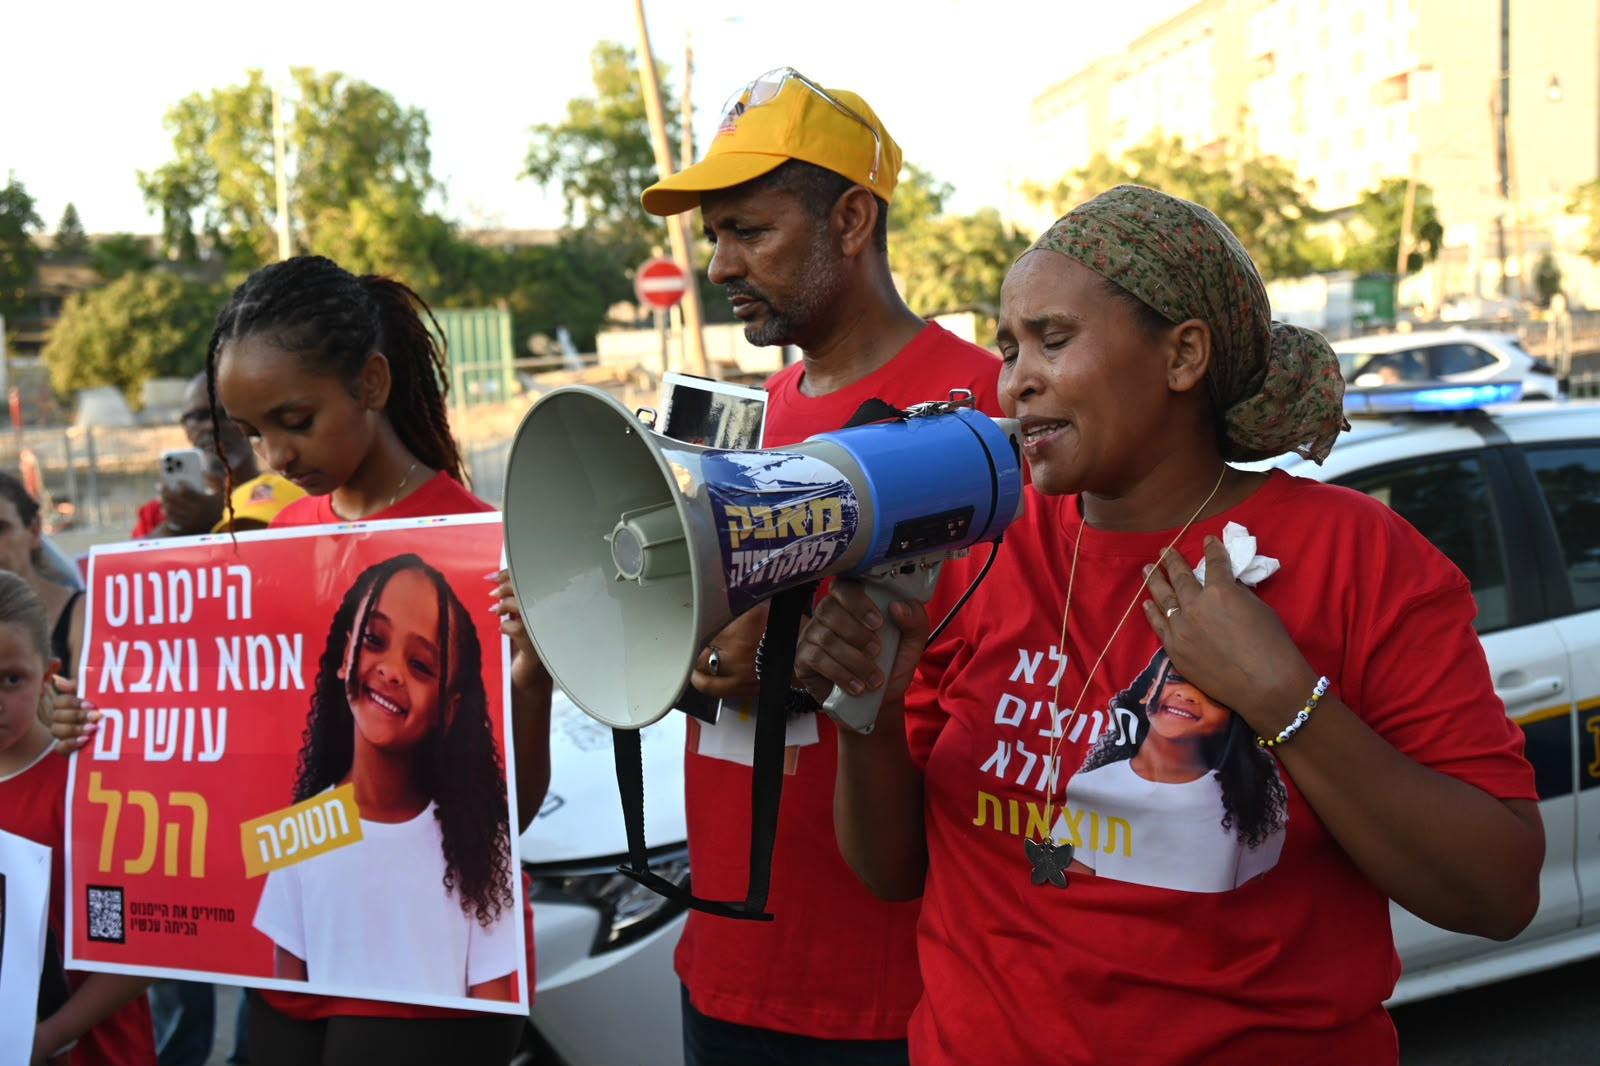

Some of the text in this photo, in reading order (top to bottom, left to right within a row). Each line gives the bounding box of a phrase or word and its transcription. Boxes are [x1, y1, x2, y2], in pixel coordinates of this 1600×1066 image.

[723, 496, 842, 549] מאבק
[105, 565, 252, 627] היימנוט
[98, 633, 305, 693] אמא ואבא
[1008, 645, 1068, 687] לא
[93, 707, 227, 762] עושים
[979, 739, 1061, 794] אלא
[88, 771, 209, 878] הכל
[256, 799, 350, 864] חטופה
[972, 790, 1133, 858] תוצאות
[130, 918, 197, 936] הביתה עכשיו
[172, 904, 188, 919] את
[192, 905, 235, 922] מחזירים
